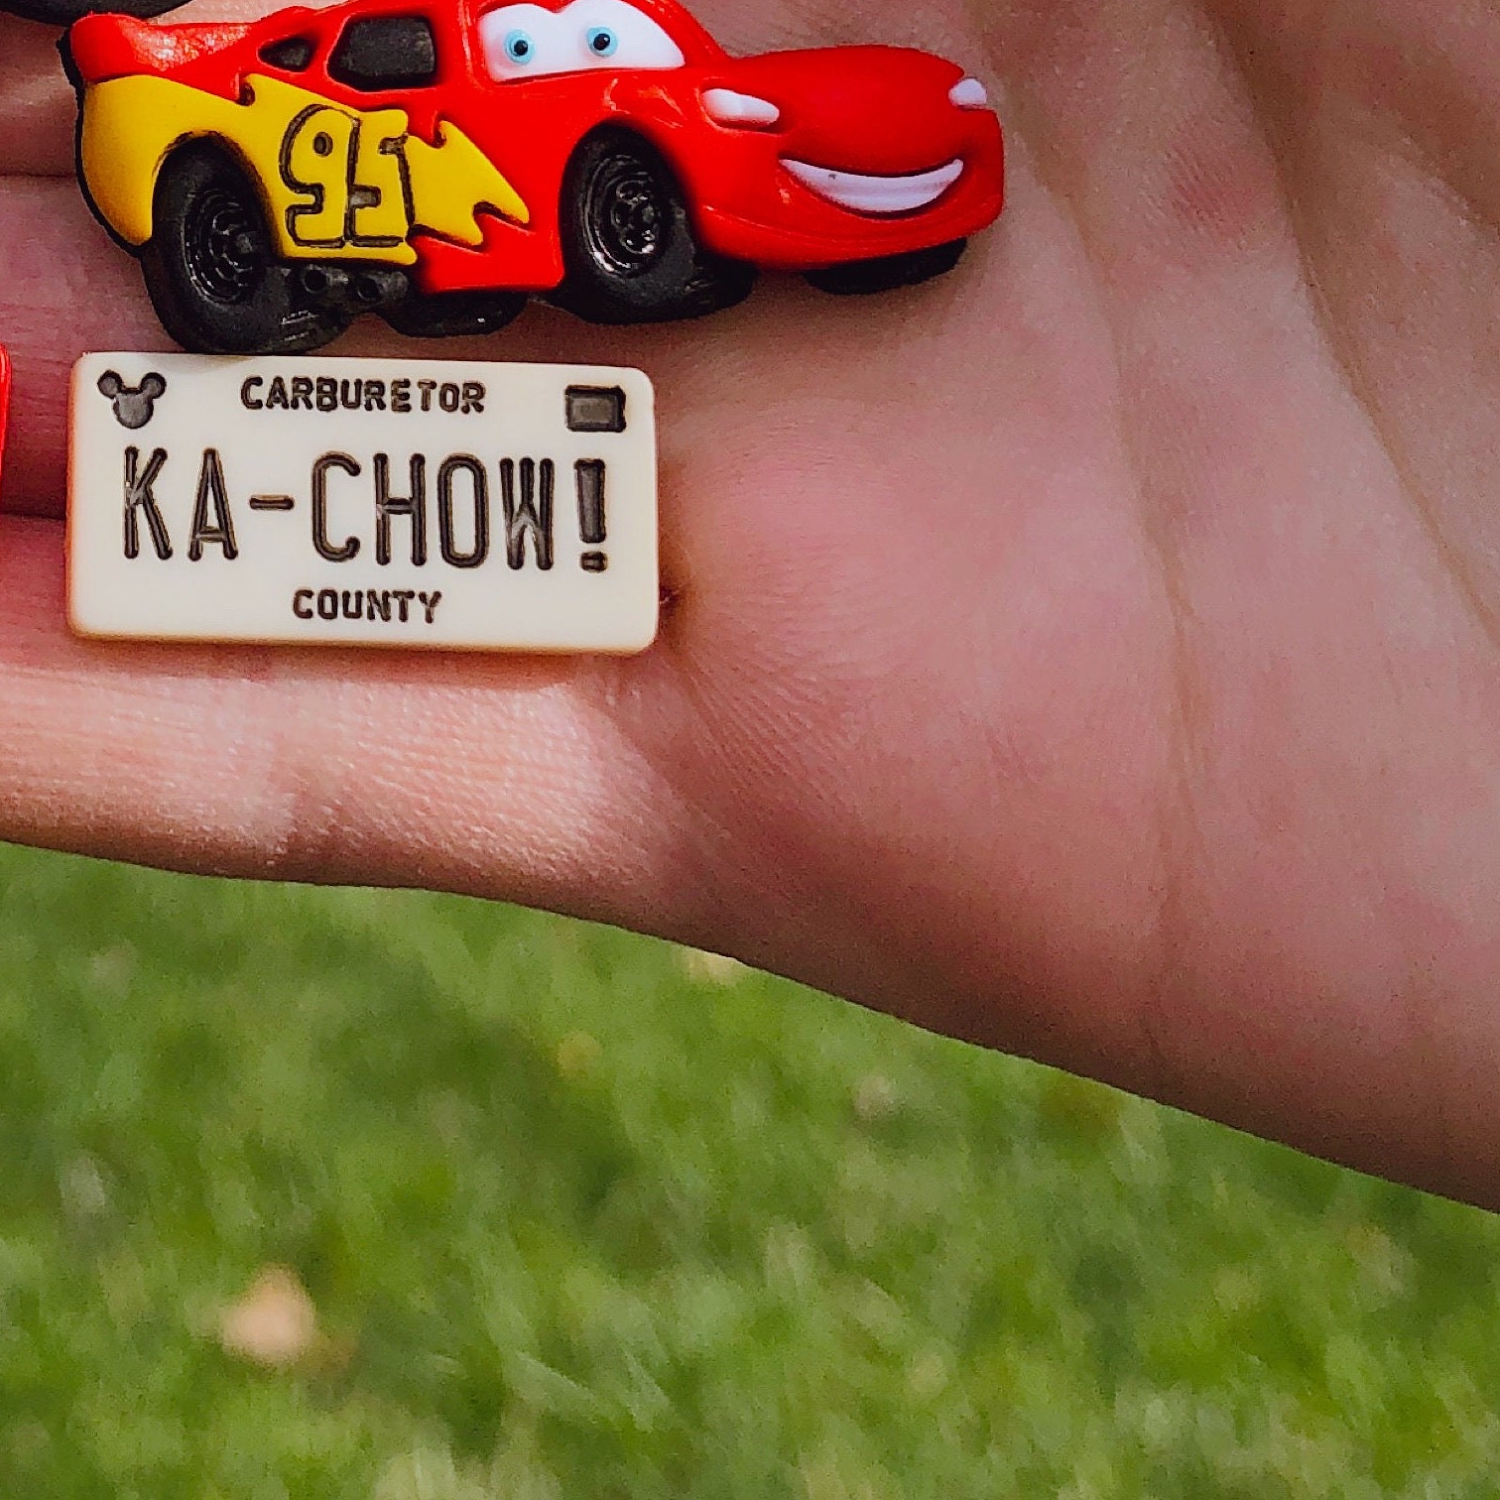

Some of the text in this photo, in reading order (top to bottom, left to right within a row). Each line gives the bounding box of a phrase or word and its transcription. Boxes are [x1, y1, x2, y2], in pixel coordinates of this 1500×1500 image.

[280, 102, 415, 250] 95
[240, 375, 486, 414] CARBURETOR
[123, 446, 608, 572] KA-CHOW!
[292, 588, 442, 624] COUNTY
